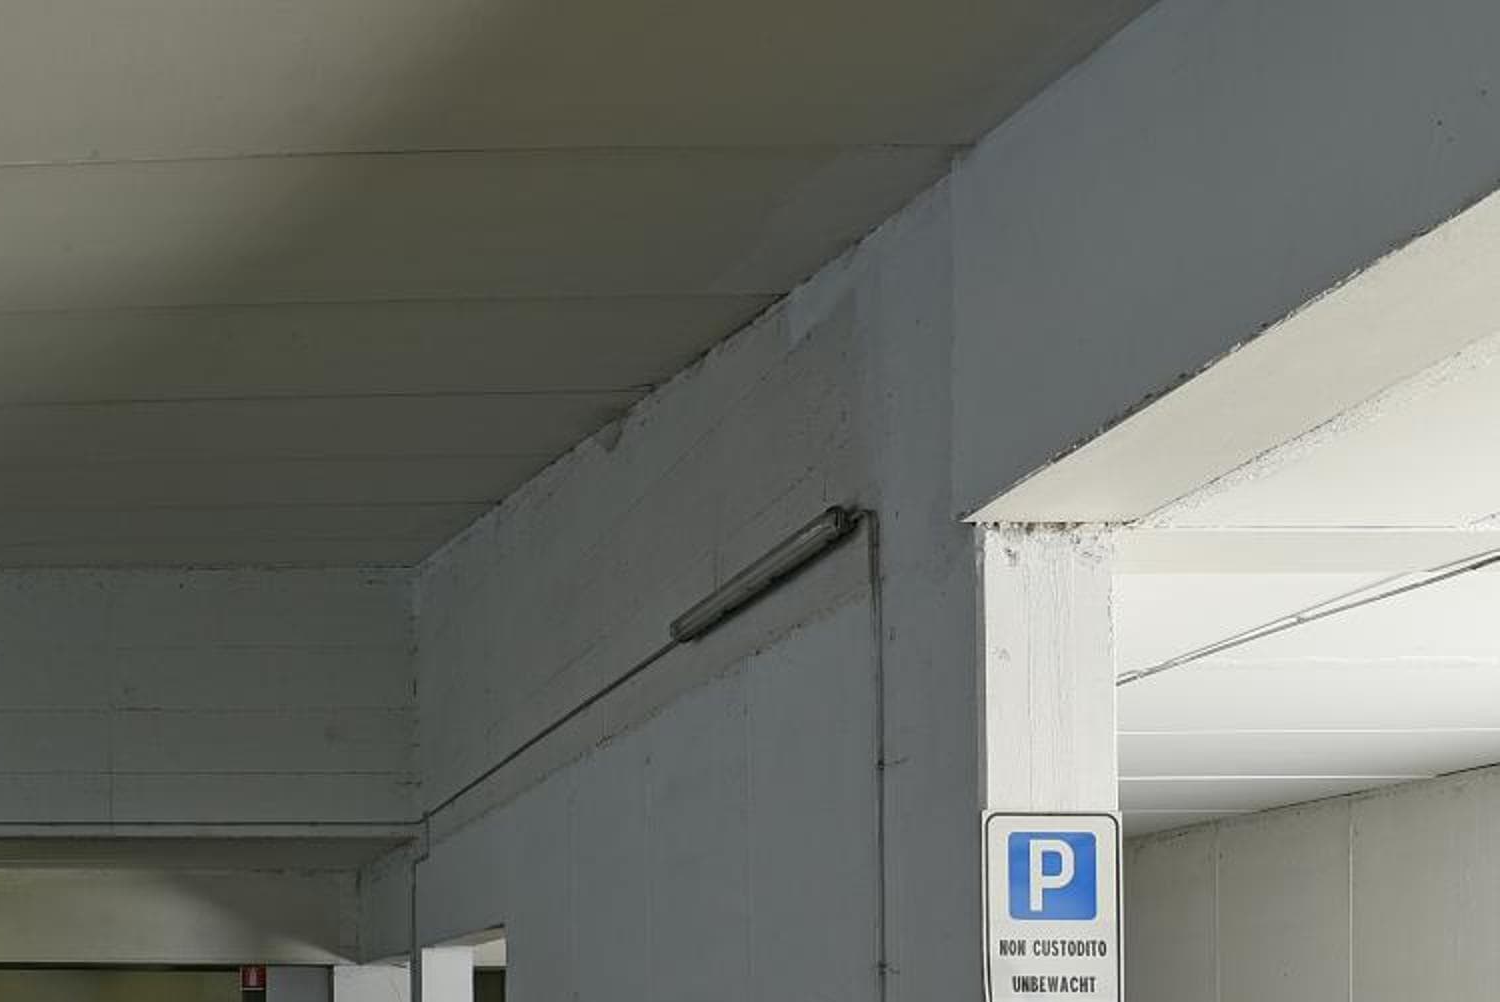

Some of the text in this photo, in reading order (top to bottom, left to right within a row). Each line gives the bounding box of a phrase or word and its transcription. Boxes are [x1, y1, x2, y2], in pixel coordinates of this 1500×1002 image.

[1029, 839, 1075, 912] P
[999, 939, 1107, 957] NON CUSTODITO
[1012, 975, 1097, 993] UNBEWACHT
